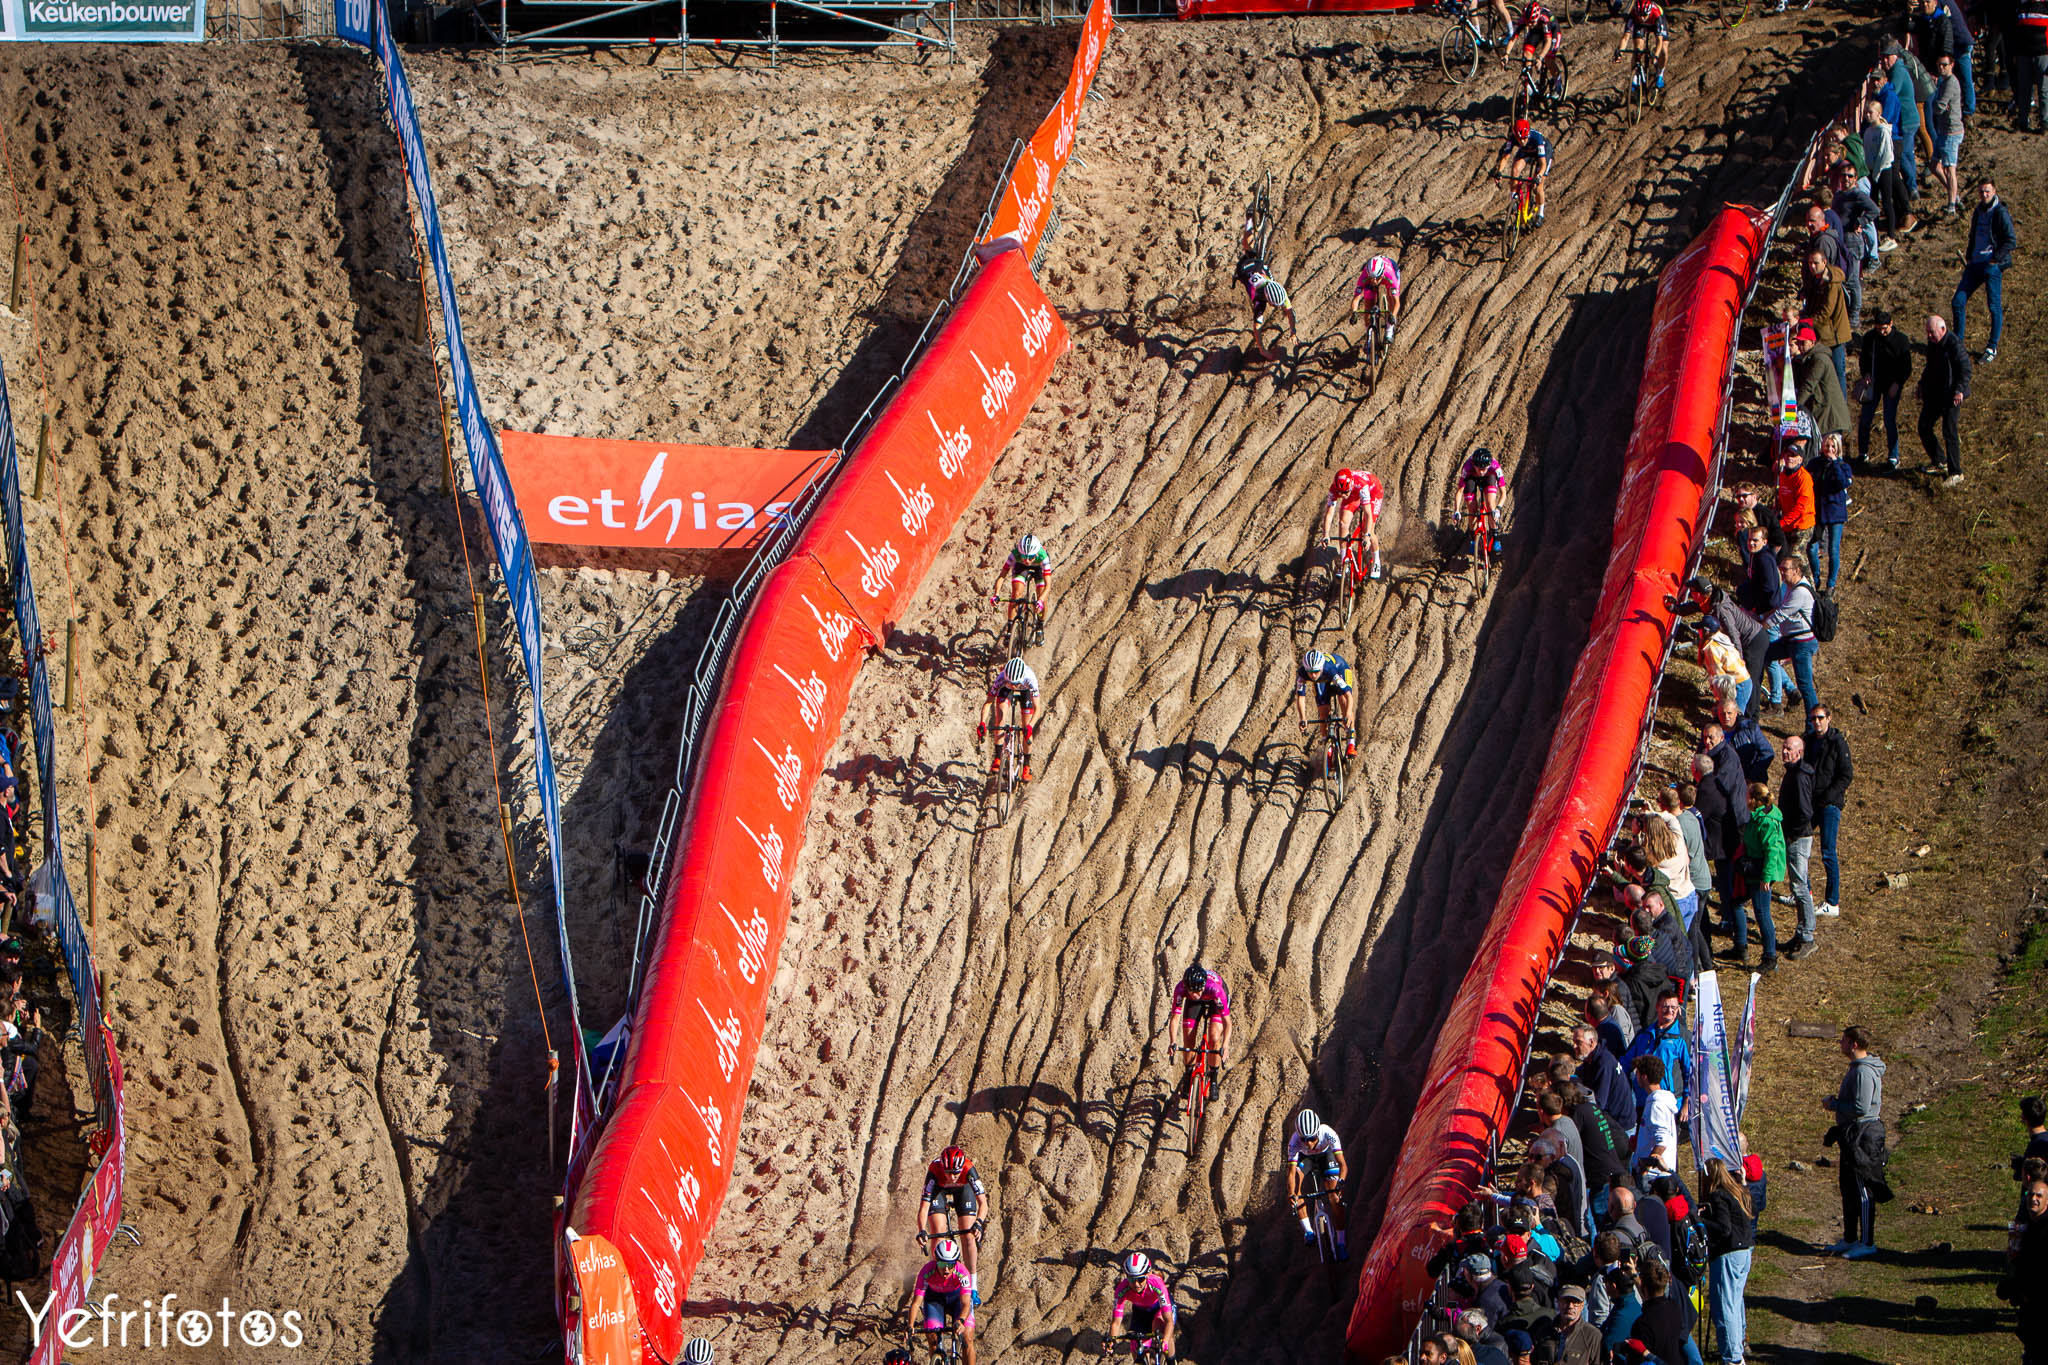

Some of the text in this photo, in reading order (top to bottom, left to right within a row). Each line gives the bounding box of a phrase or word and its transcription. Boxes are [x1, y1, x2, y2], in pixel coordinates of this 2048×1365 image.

[30, 1, 190, 23] Keukenbouwer
[1012, 180, 1041, 242] ethias
[970, 349, 1016, 419] ethias
[928, 410, 972, 479] ethias
[485, 457, 519, 572] TIRES
[547, 451, 792, 544] ethias
[885, 470, 935, 536] ethias
[844, 529, 901, 599] ethias
[773, 663, 828, 733] ethias
[753, 737, 801, 812] ethias
[736, 816, 784, 892] ethias
[718, 901, 769, 984] ethias
[580, 1241, 617, 1276] ethias
[589, 1296, 626, 1332] ethias
